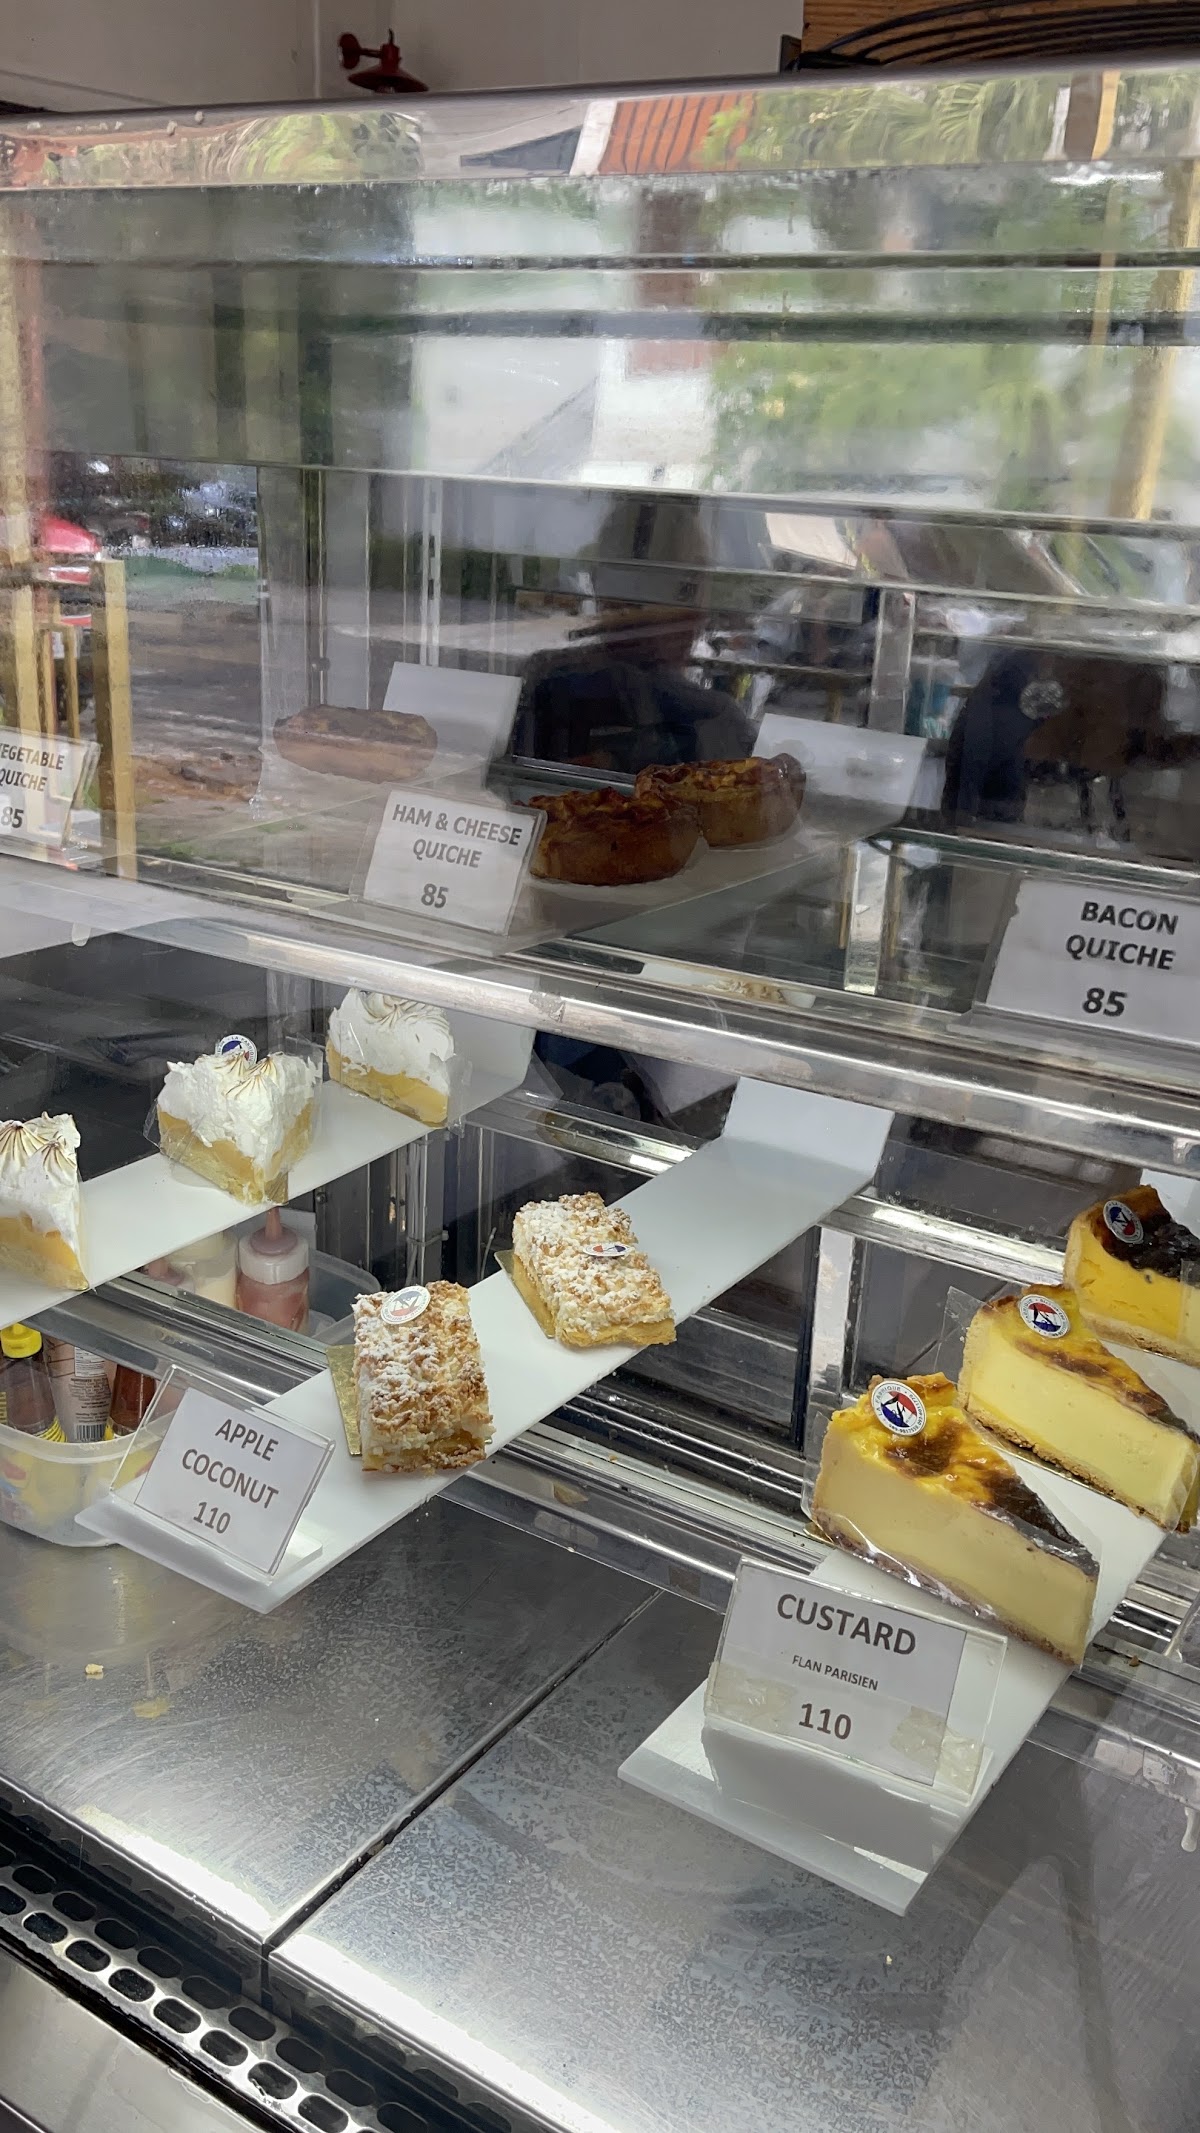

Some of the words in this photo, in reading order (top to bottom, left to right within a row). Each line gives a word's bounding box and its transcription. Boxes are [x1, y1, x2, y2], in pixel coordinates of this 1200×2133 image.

[0, 743, 65, 770] EGETABLE
[0, 768, 47, 791] QUICHE
[0, 806, 24, 829] 85
[392, 804, 432, 828] HAM
[435, 812, 448, 832] &
[453, 816, 522, 846] CHEESE
[412, 838, 482, 868] QUICHE
[420, 883, 449, 909] 85
[1081, 901, 1179, 935] BACON
[1066, 934, 1176, 970] QUICHE
[1082, 987, 1128, 1017] 85
[215, 1418, 279, 1461] APPLE
[182, 1448, 279, 1508] COCONUT
[193, 1501, 231, 1534] 110
[777, 1593, 916, 1655] CUSTARD
[792, 1654, 822, 1674] FLAN
[823, 1663, 879, 1691] PARISIEN
[798, 1702, 852, 1740] 110
